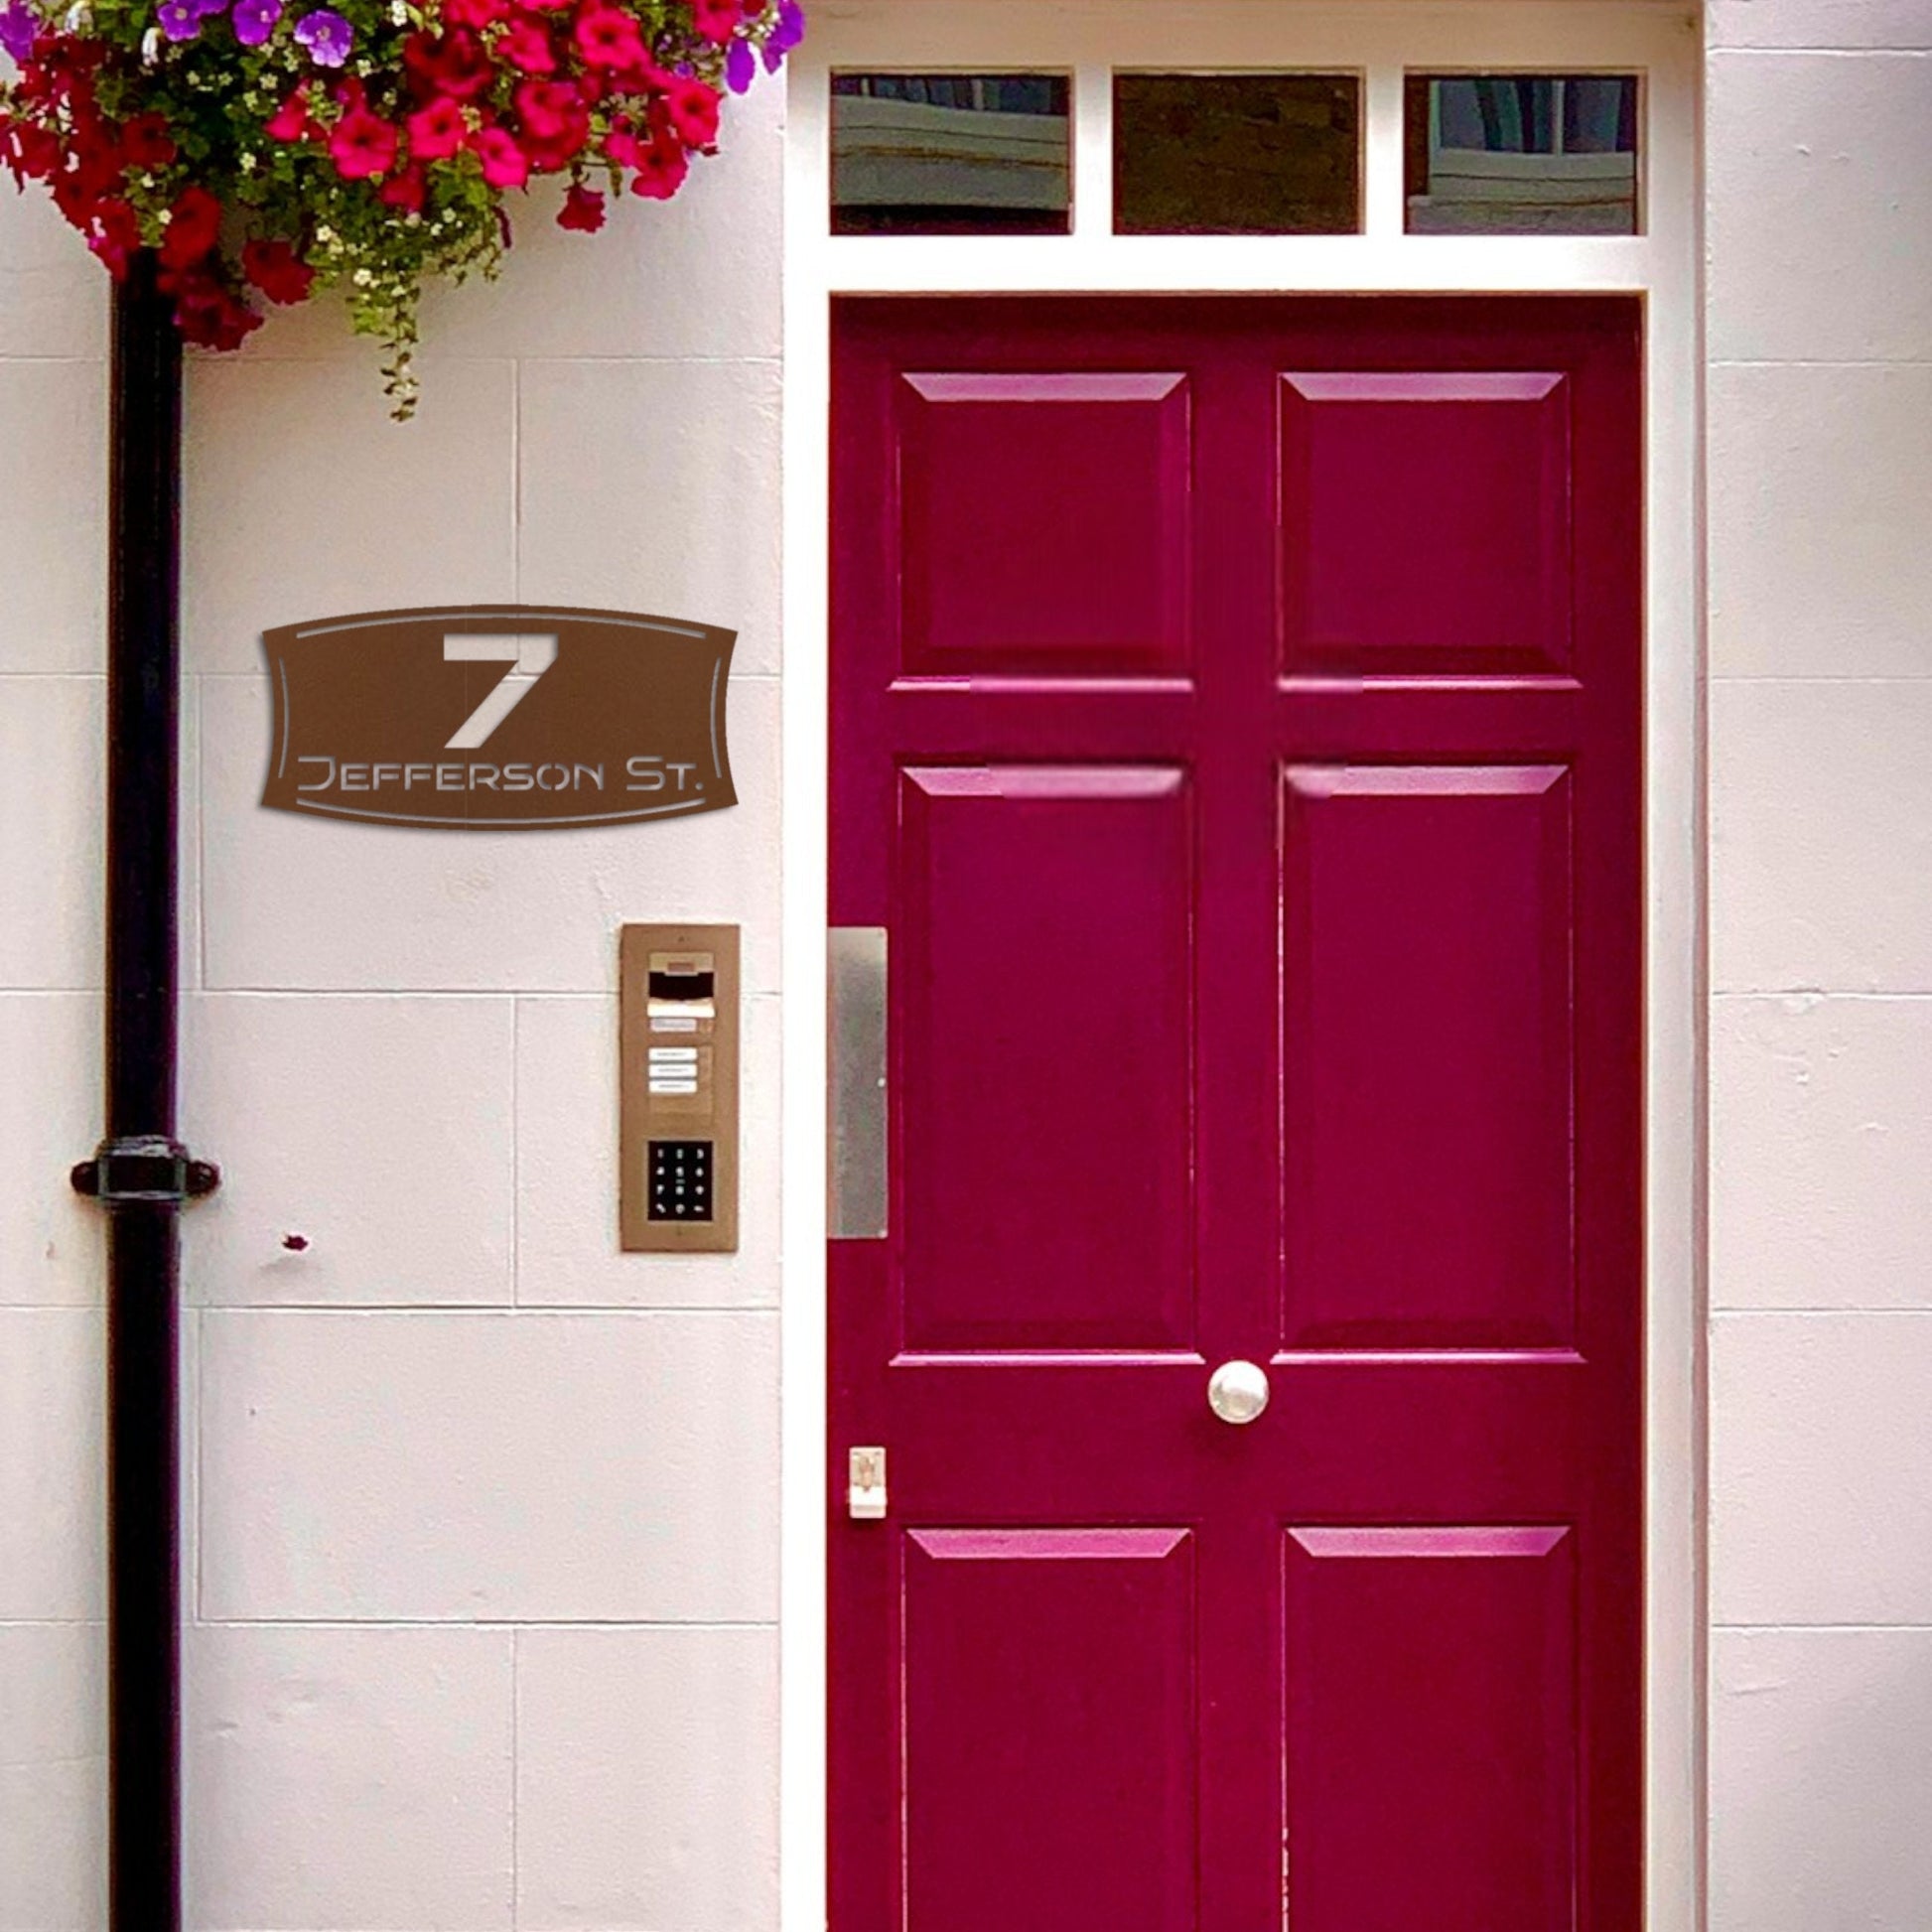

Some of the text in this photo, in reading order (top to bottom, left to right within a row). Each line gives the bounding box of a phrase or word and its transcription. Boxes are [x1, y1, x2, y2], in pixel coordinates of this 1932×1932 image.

[443, 632, 559, 750] 7
[297, 755, 704, 792] JEFFERSON ST.
